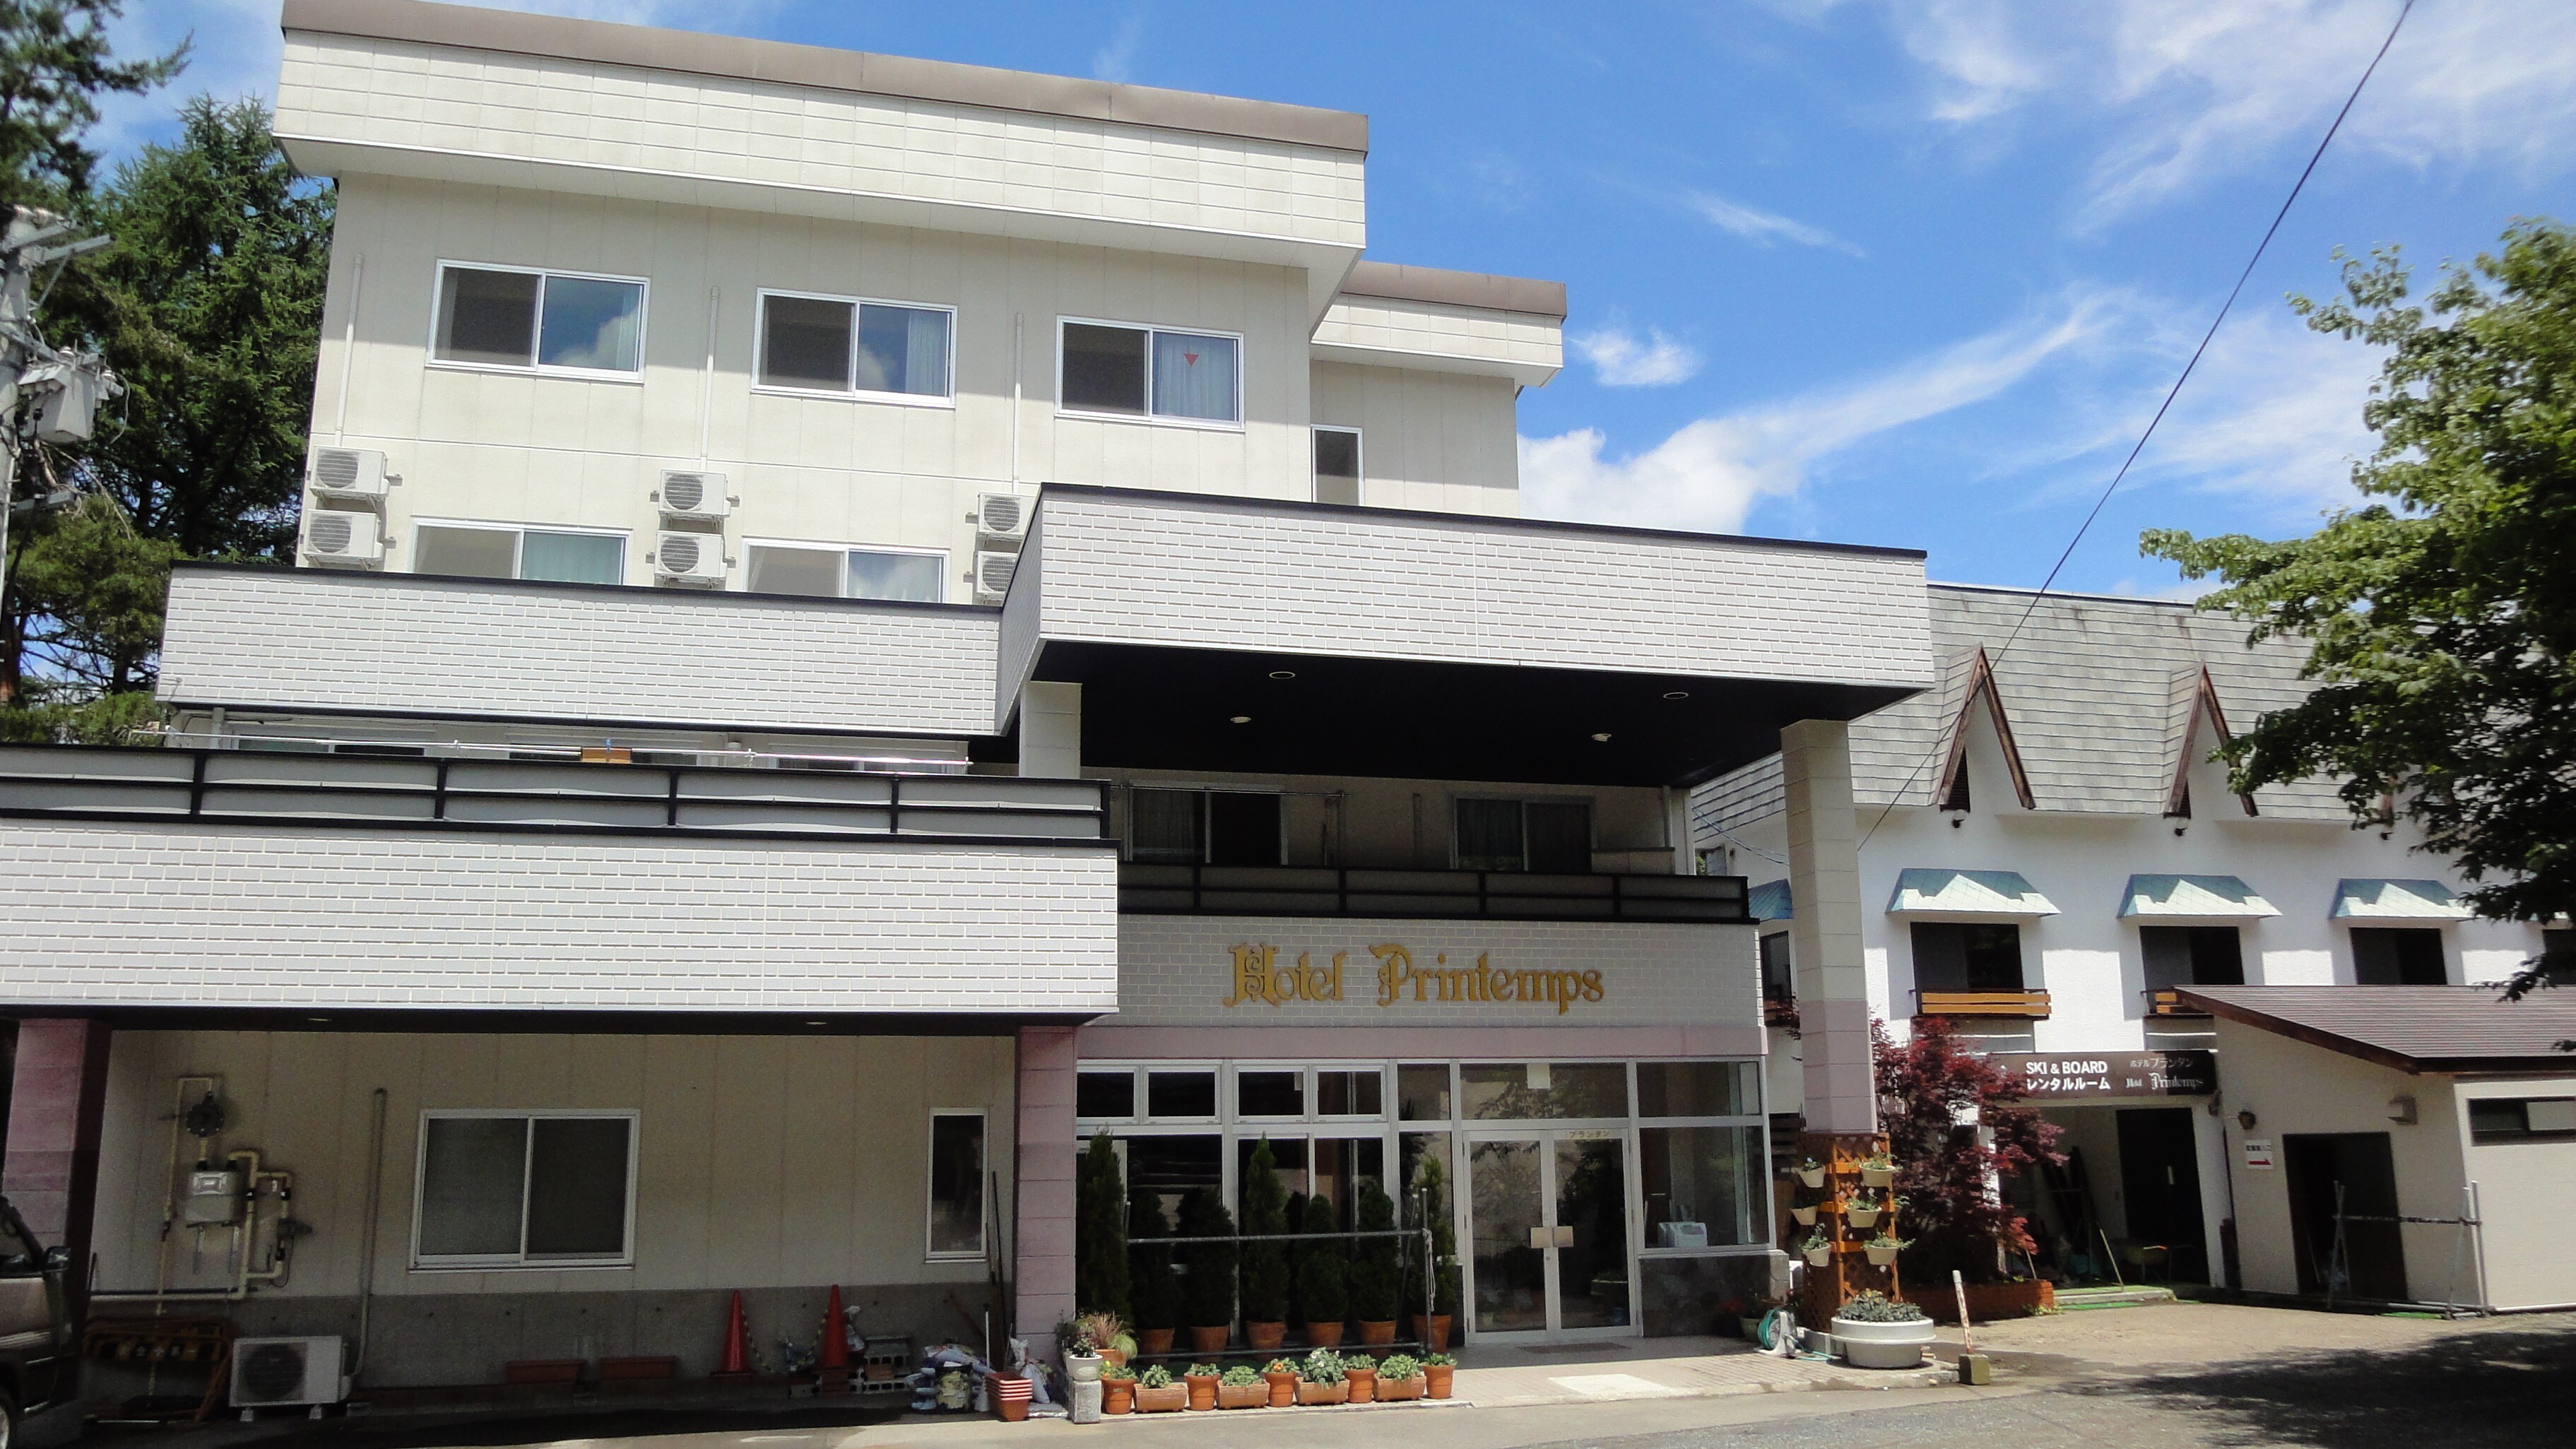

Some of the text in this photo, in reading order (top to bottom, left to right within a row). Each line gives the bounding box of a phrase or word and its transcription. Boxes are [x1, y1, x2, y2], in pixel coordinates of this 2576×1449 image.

[1222, 942, 1605, 1015] Hotel Printemps
[2026, 1060, 2108, 1075] SKI & BOARD
[2026, 1076, 2111, 1092] レンタルルーム
